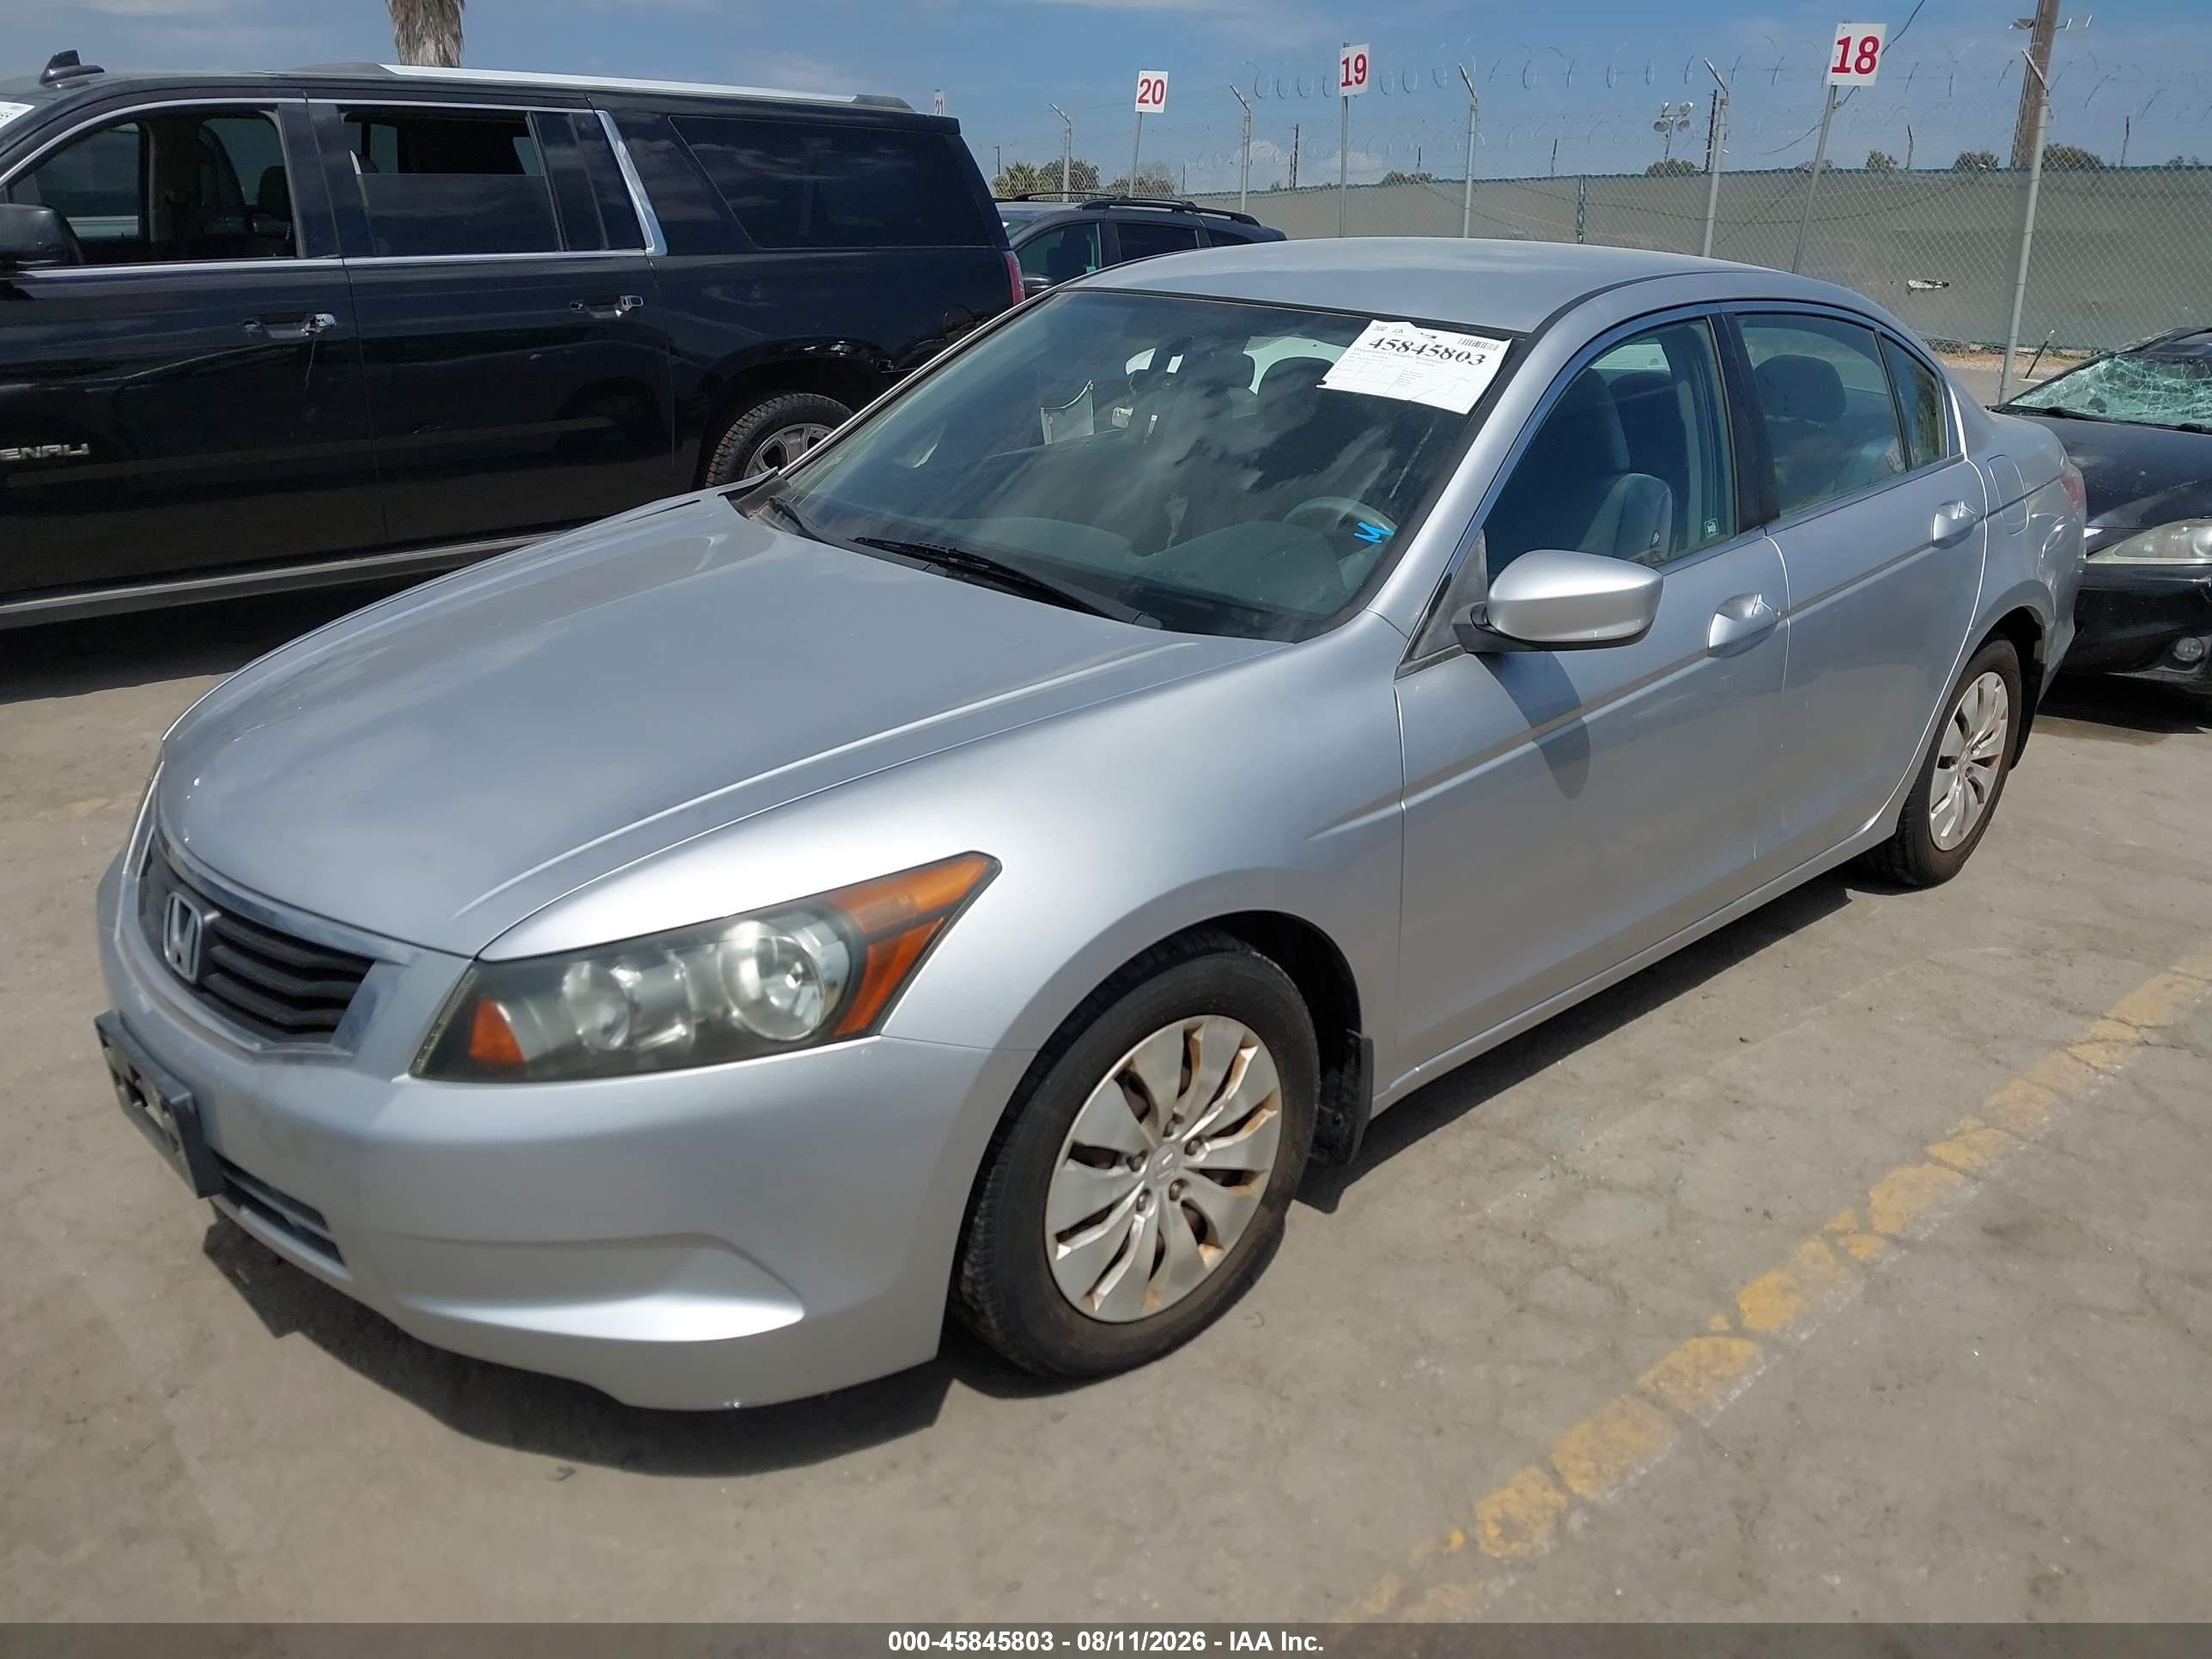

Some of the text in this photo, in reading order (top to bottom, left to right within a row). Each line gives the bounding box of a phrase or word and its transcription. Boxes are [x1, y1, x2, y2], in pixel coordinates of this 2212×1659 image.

[1340, 53, 1367, 87] 19
[1831, 35, 1880, 75] 18
[1137, 78, 1165, 105] 20
[1368, 337, 1486, 366] 45845803
